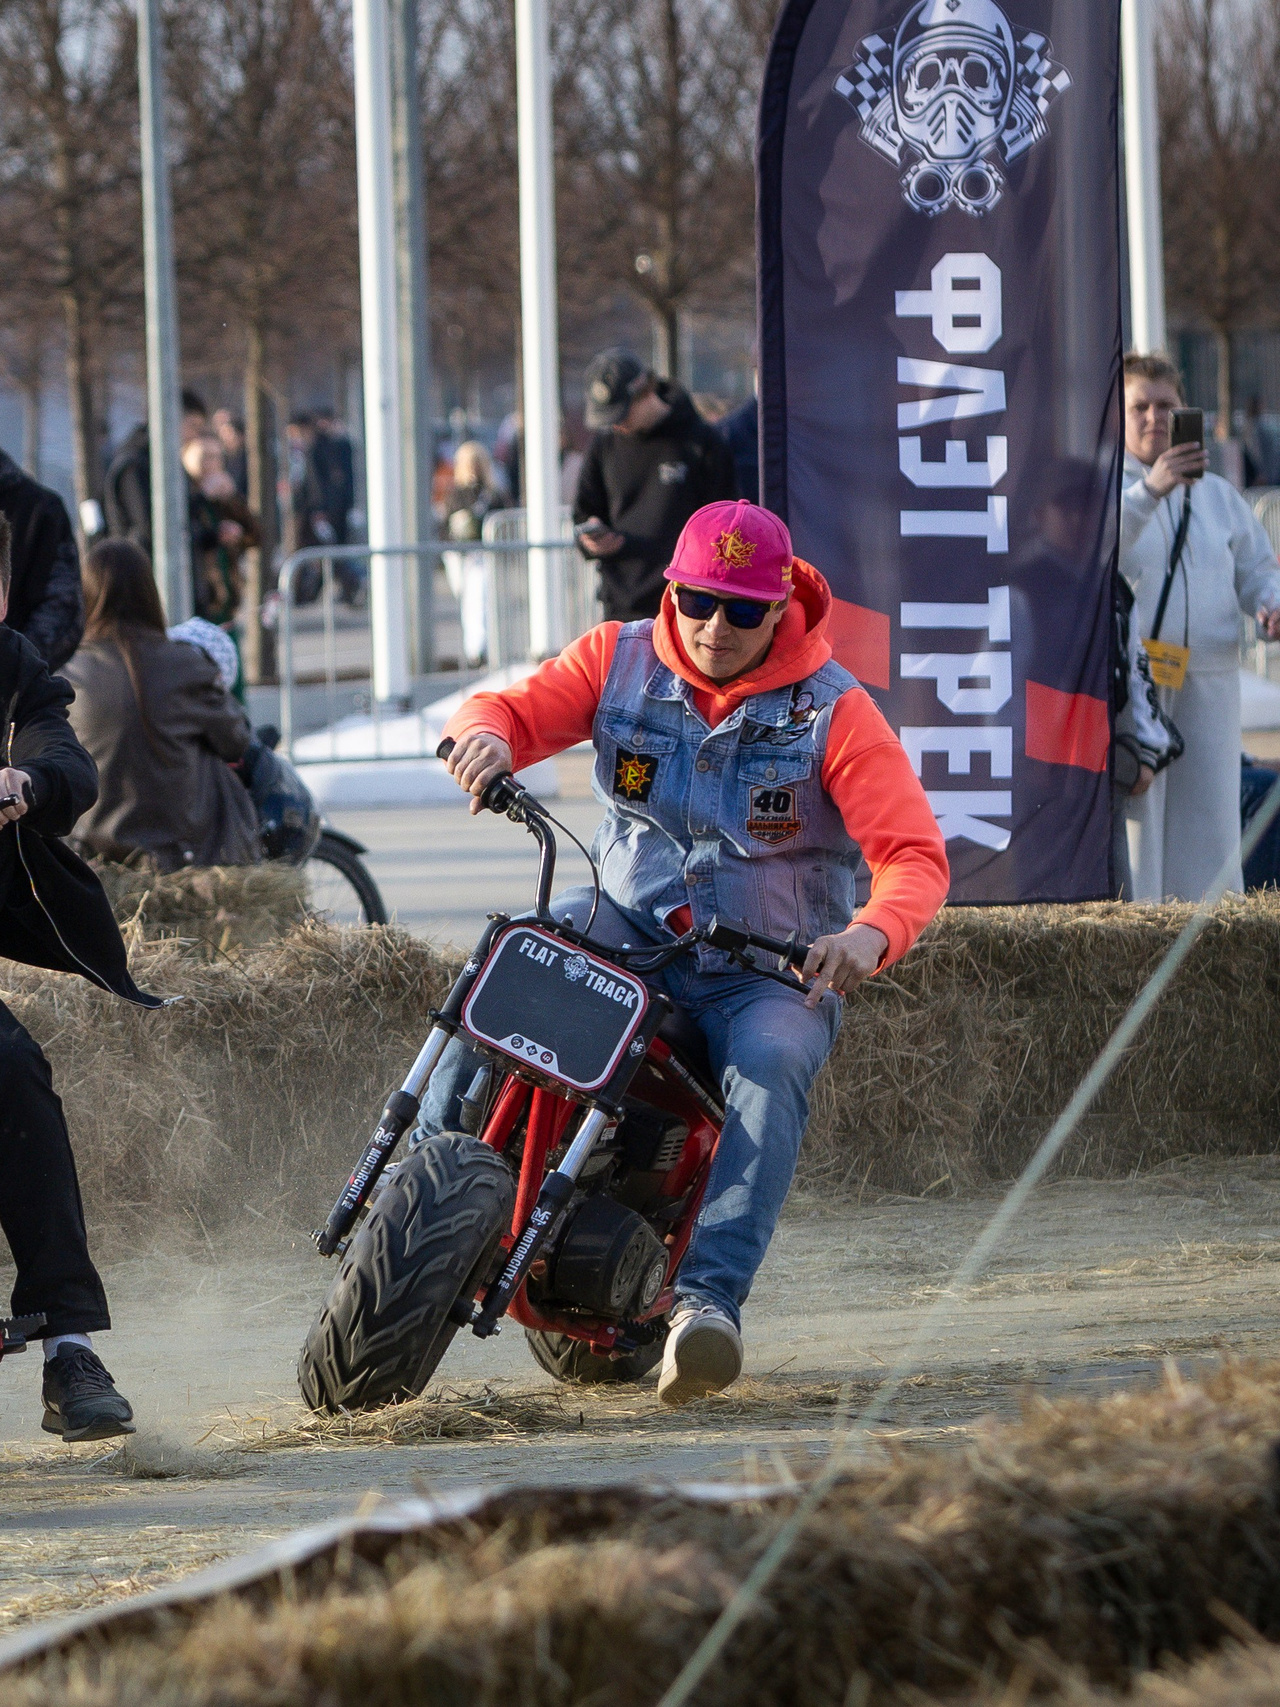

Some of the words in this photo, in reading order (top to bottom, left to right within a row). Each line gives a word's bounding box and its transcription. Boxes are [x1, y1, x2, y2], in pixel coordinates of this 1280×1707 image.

[895, 252, 1009, 554] ФЛЭТ
[753, 790, 791, 813] 40
[900, 585, 1013, 852] ТРЕК
[519, 938, 559, 967] FLAT
[584, 972, 639, 1009] TRACK
